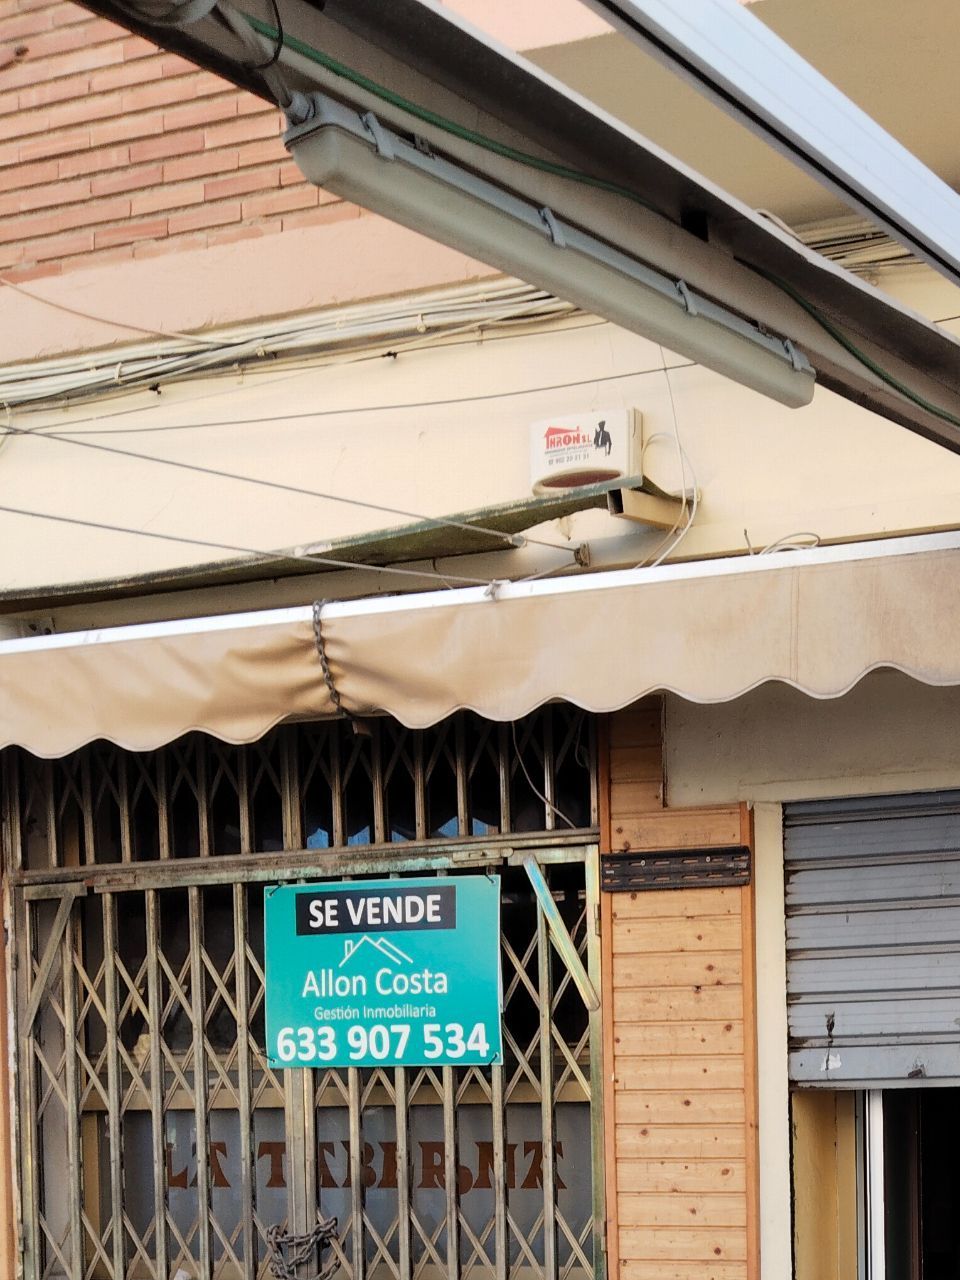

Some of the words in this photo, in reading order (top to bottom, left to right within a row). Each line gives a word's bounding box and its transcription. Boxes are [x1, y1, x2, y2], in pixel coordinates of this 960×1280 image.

[309, 899, 338, 928] SE
[346, 894, 441, 926] VENDE
[302, 969, 367, 998] Allon
[375, 967, 448, 995] Costa
[314, 1005, 360, 1020] Gestión
[363, 1003, 436, 1019] Inmobiliaria
[276, 1026, 337, 1062] 633
[347, 1024, 411, 1060] 907
[423, 1022, 490, 1059] 534
